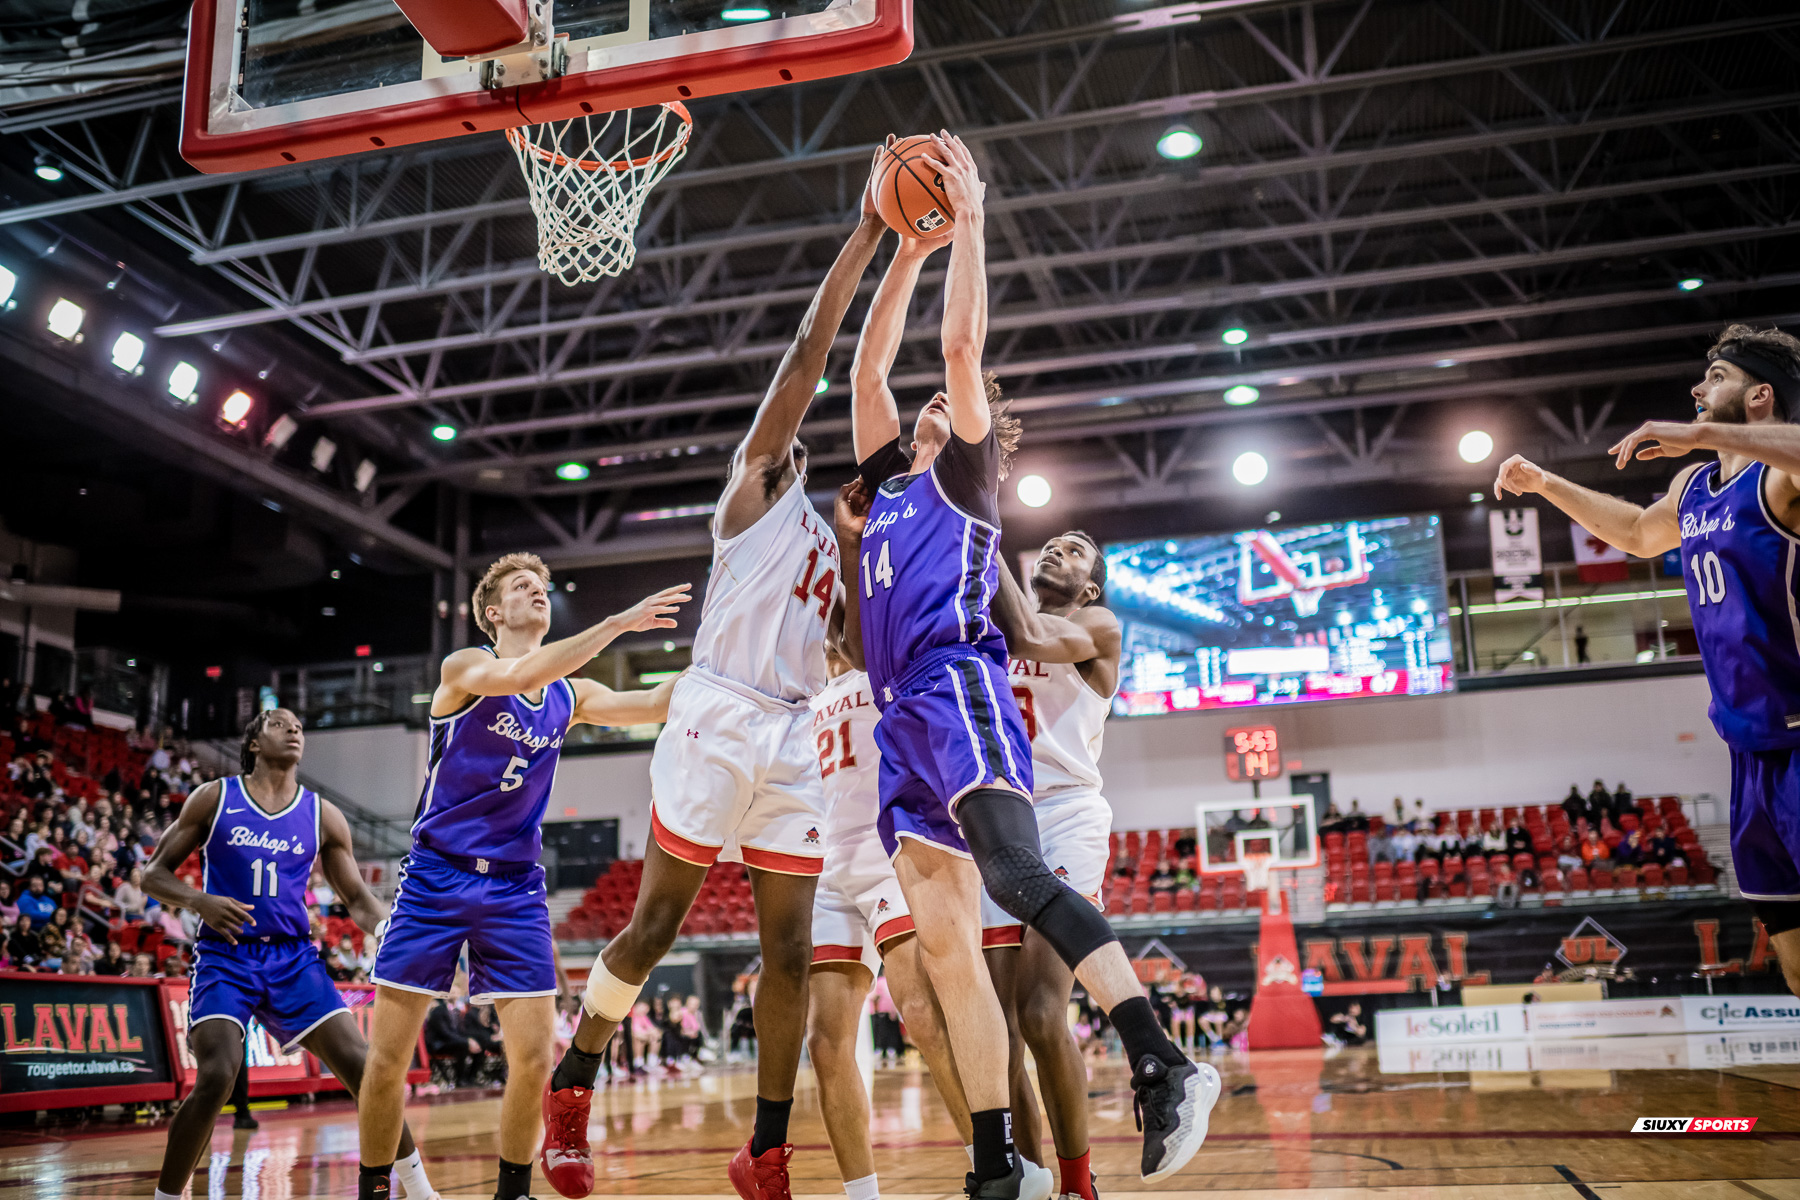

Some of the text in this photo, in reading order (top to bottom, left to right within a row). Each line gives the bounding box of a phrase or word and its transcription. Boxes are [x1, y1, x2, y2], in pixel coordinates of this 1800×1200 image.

[791, 546, 835, 621] 14
[862, 539, 894, 599] 14
[1690, 551, 1727, 607] 10
[813, 691, 869, 727] AVAL
[487, 712, 562, 754] Bishop's
[817, 718, 857, 780] 21
[500, 755, 529, 792] 5
[227, 826, 305, 855] Bishop's
[251, 858, 278, 897] 11
[1303, 931, 1492, 992] AVAL
[1, 1003, 143, 1055] LAVAL
[1701, 1002, 1800, 1025] ClicAssu
[27, 1060, 136, 1079] rougeetor.ulaval.ca
